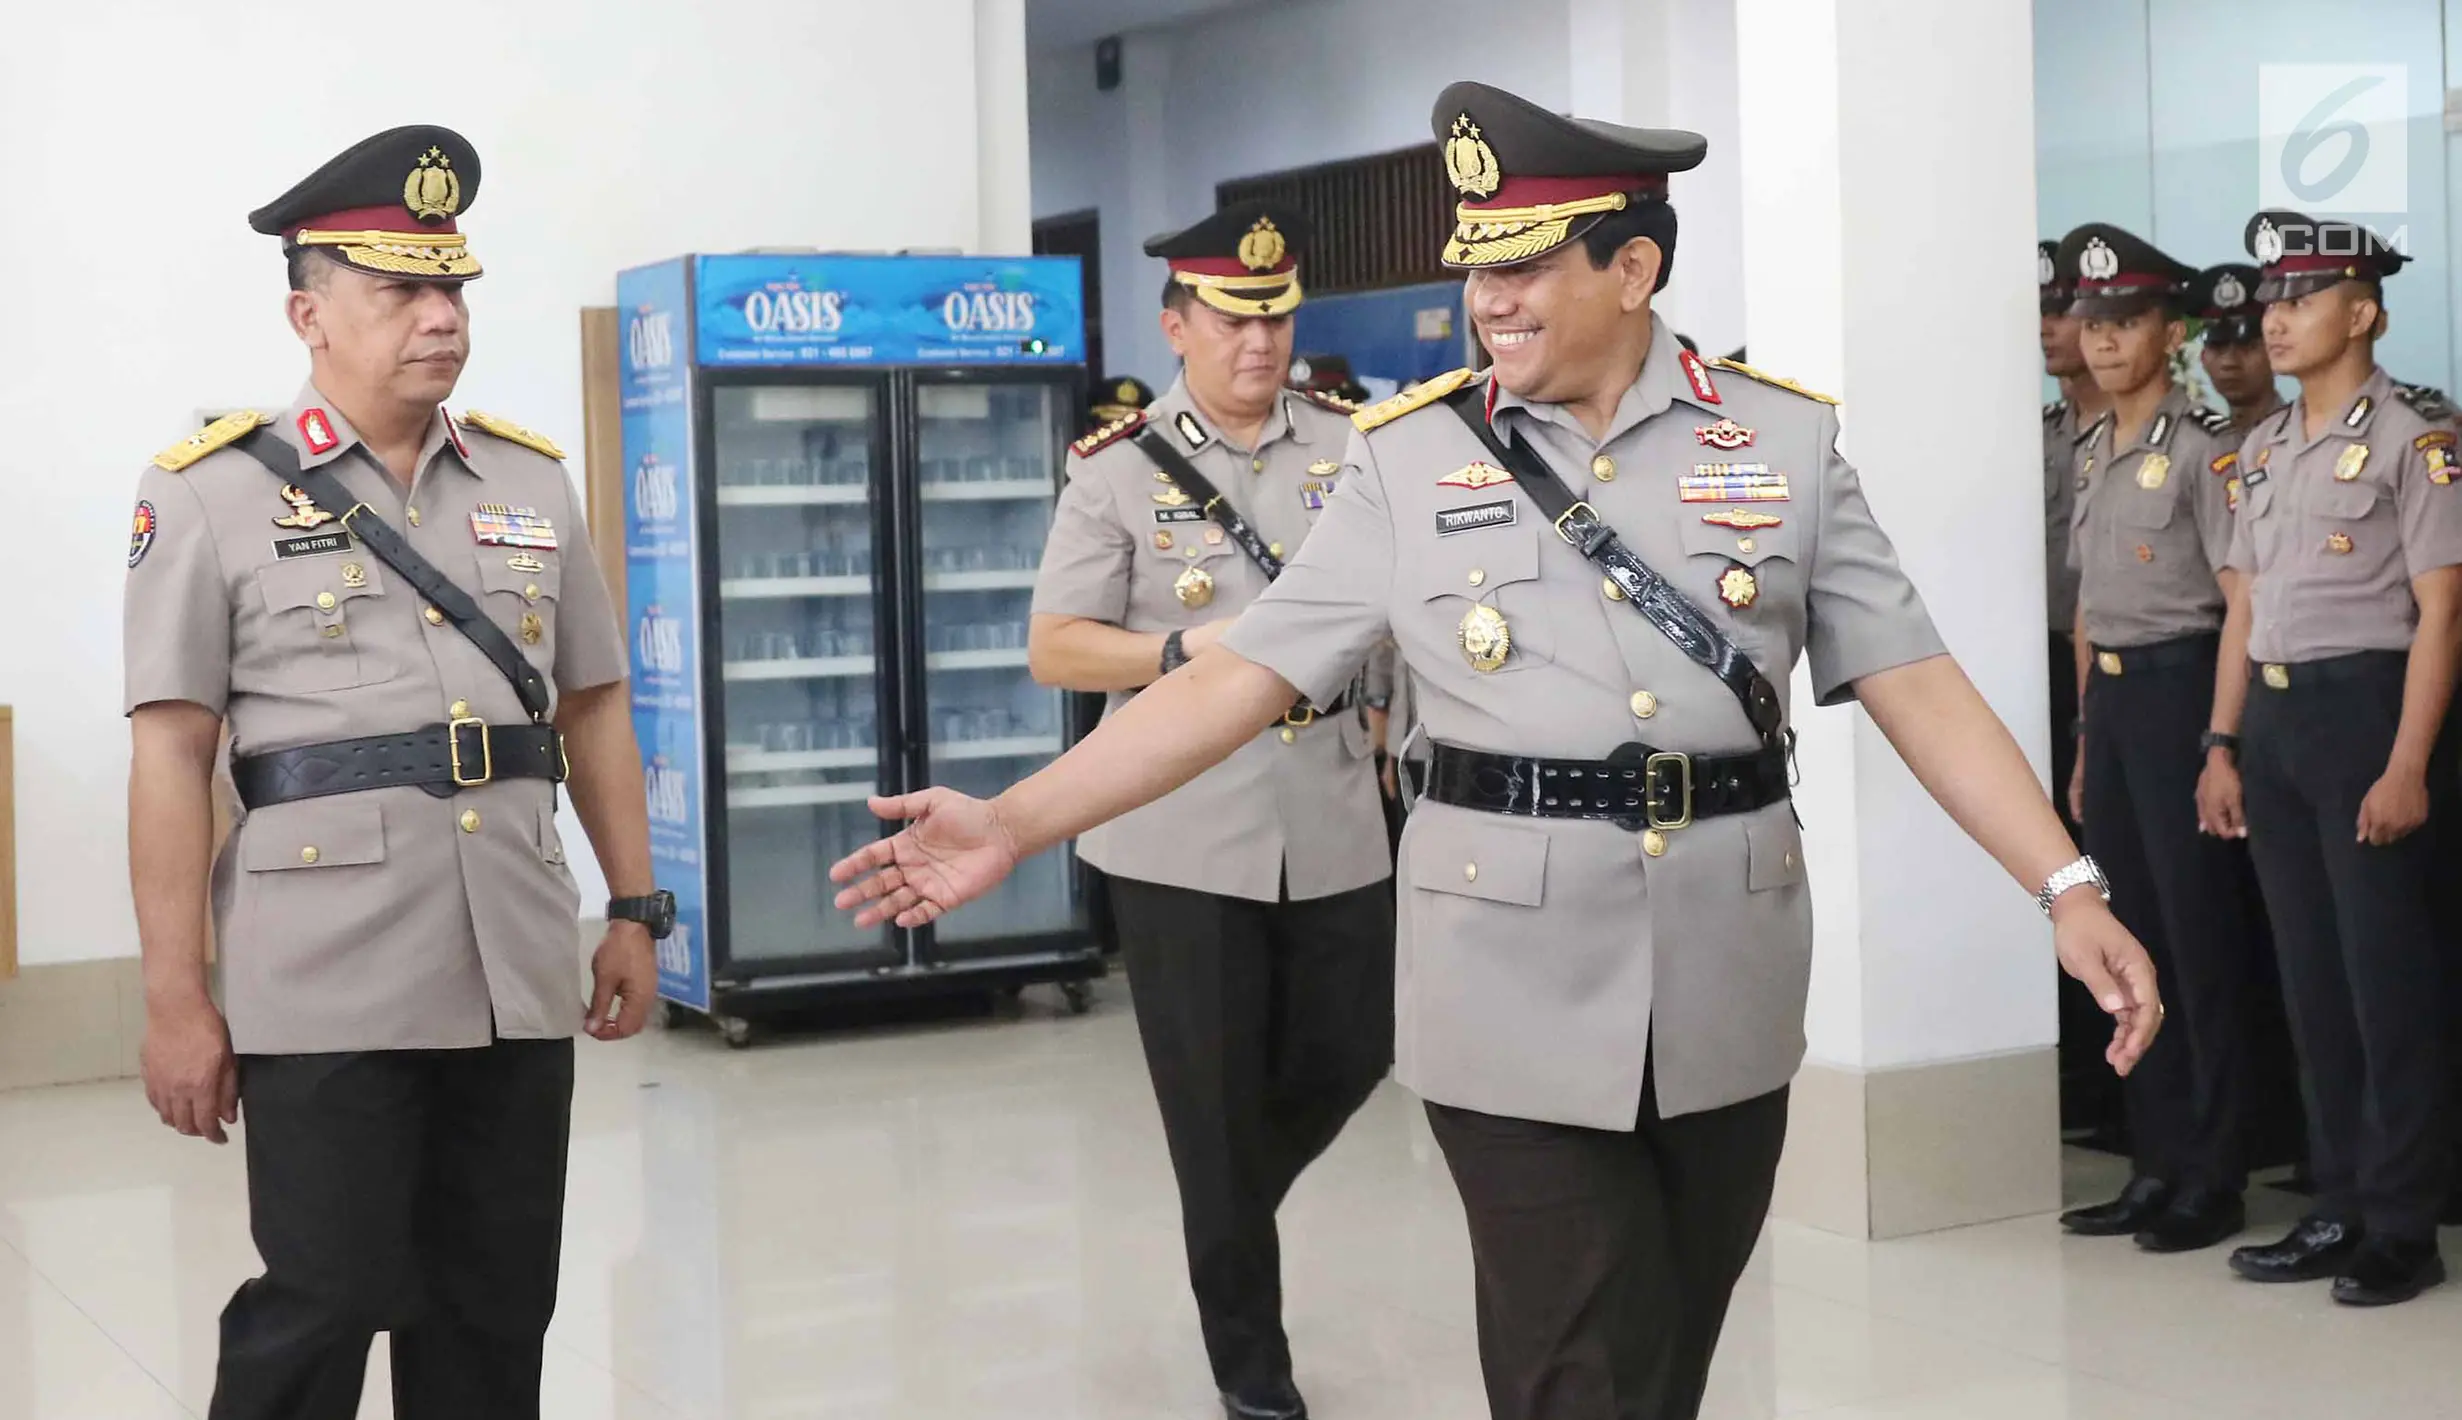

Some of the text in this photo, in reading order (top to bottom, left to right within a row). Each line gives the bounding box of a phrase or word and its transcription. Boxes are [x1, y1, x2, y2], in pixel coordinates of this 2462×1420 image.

[745, 290, 843, 333] OASIS
[944, 290, 1036, 332] OASIS
[630, 312, 671, 370] OASIS
[1446, 506, 1504, 527] RIKWANTO
[288, 538, 337, 552] YAN FITRI
